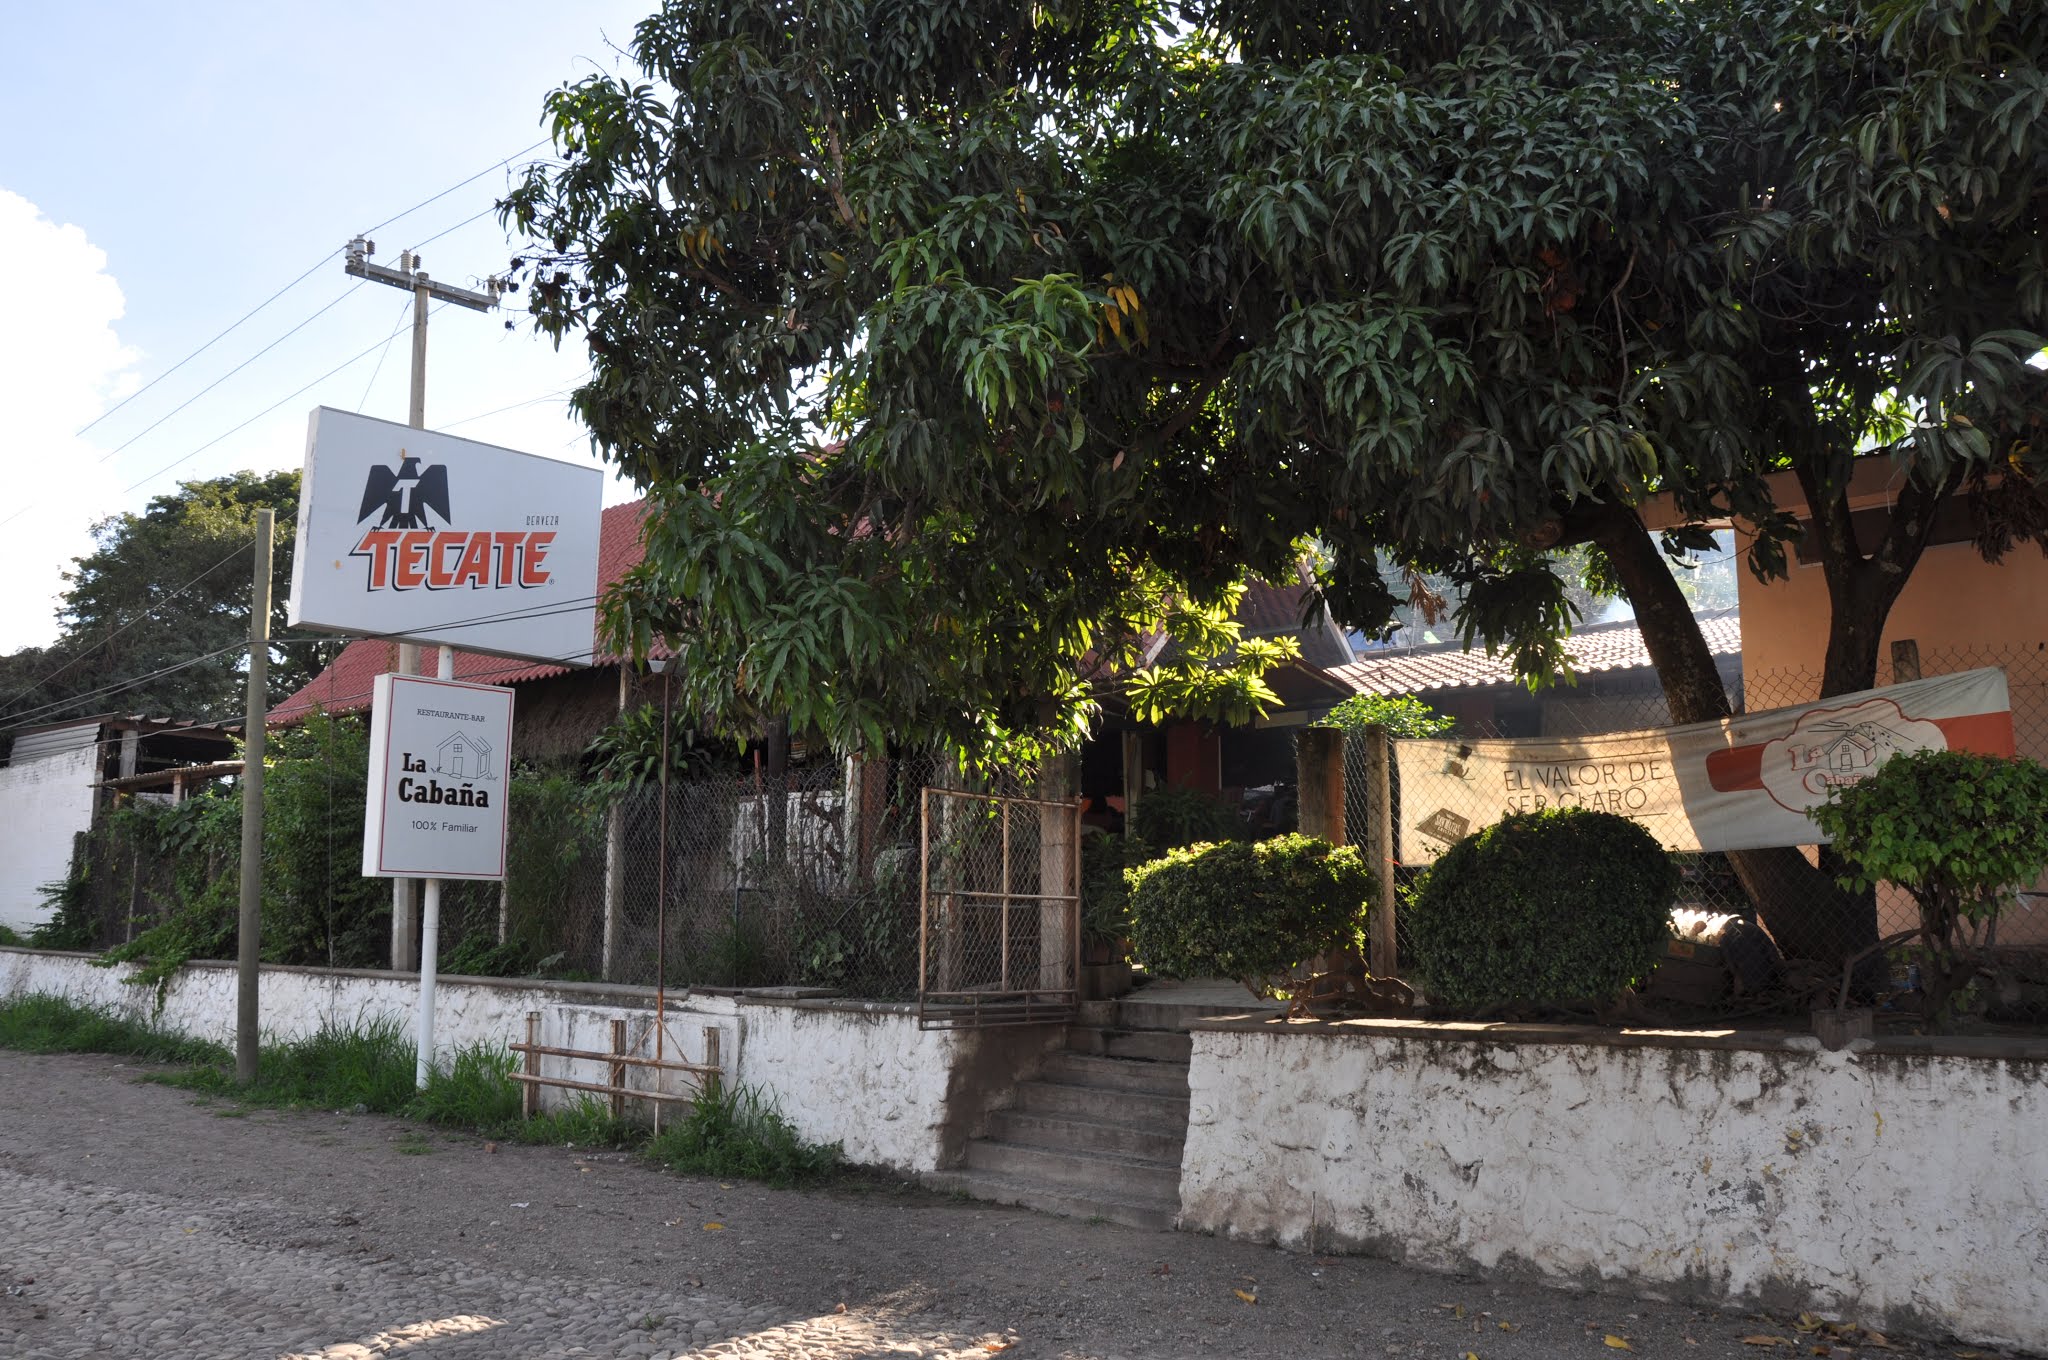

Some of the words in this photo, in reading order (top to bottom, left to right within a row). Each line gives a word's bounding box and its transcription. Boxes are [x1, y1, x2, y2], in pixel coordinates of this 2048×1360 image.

[392, 479, 420, 514] T
[525, 515, 560, 526] CERVEZA
[350, 531, 557, 591] TECATE
[417, 708, 485, 722] RESTAURANTE-BAR
[402, 752, 427, 773] La
[1504, 770, 1531, 791] EL
[1536, 763, 1618, 789] VALOR
[1628, 759, 1664, 782] DE
[398, 777, 489, 808] Cabaña
[411, 820, 437, 831] 100%
[442, 822, 478, 833] Familiar
